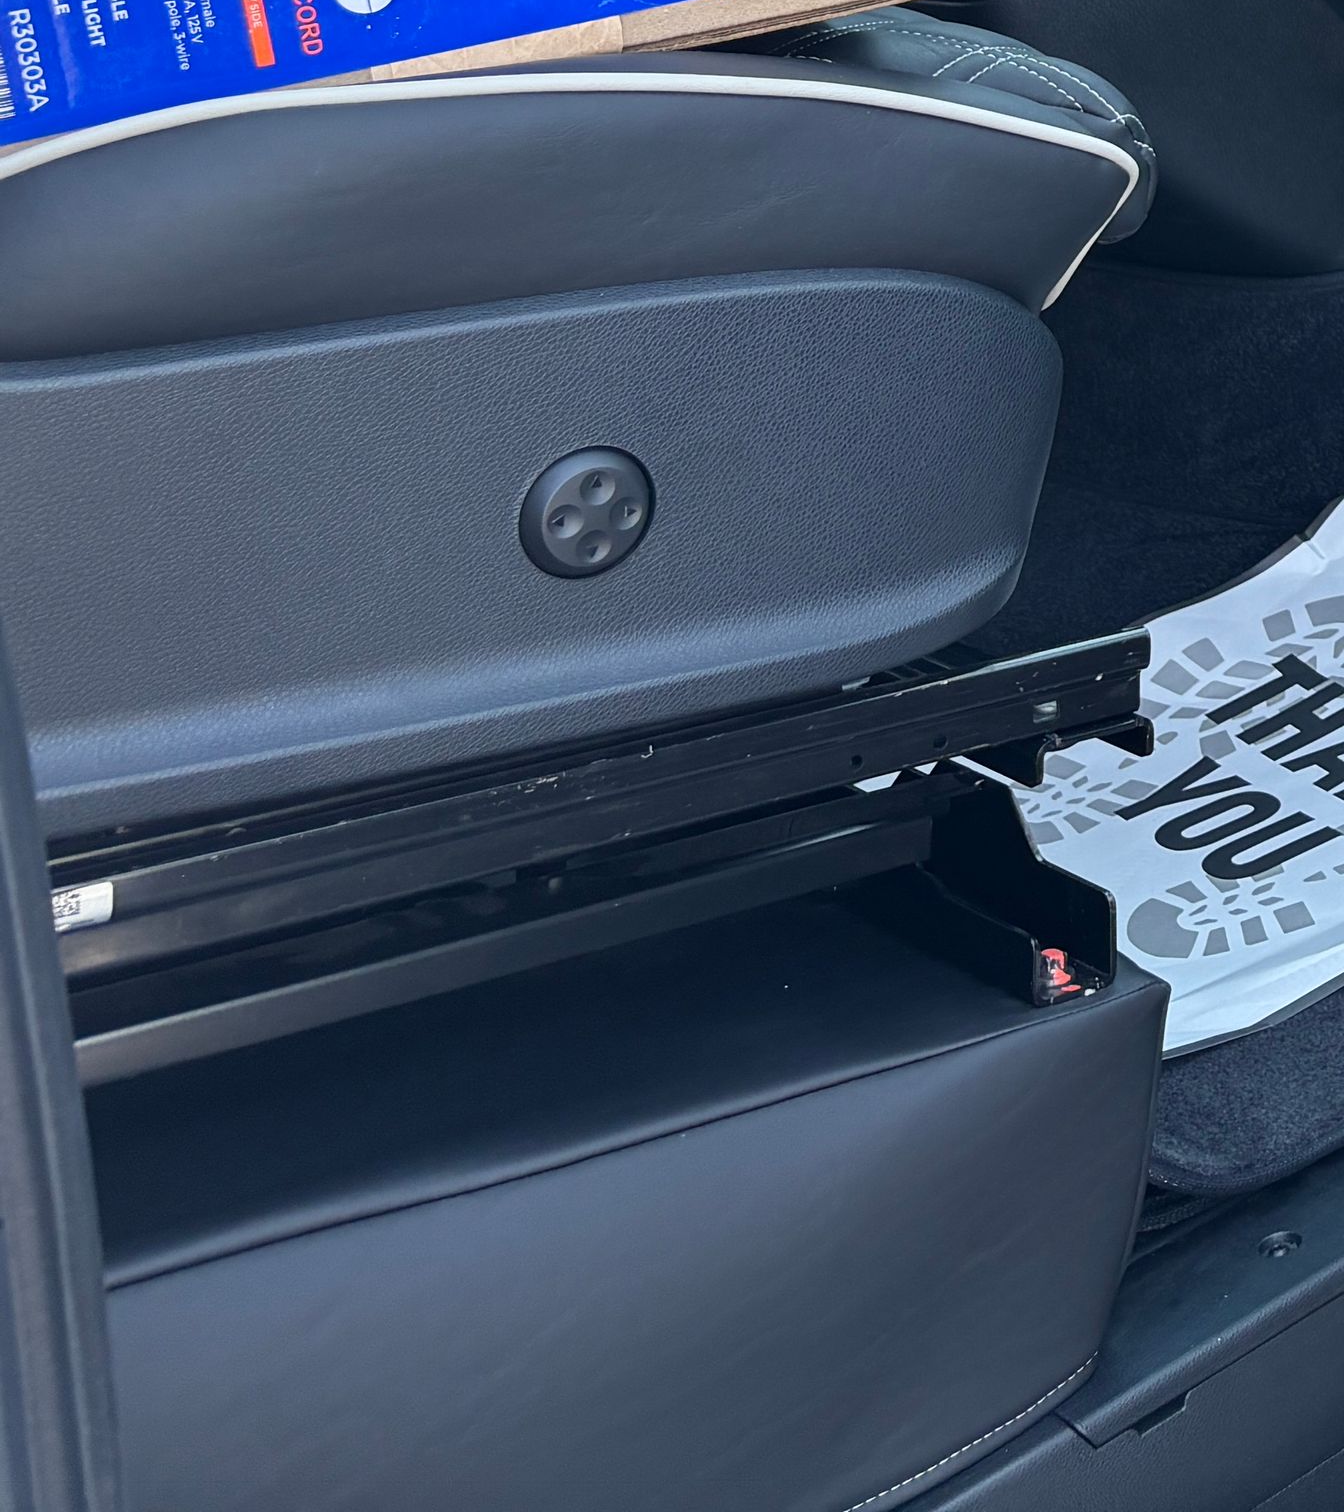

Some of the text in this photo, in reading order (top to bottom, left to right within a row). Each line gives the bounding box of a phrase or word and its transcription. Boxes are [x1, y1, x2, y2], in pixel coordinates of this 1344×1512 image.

[172, 31, 190, 71] 3-wire
[248, 2, 263, 29] SIDE
[7, 7, 50, 113] R30303A
[1115, 756, 1341, 880] YOU
